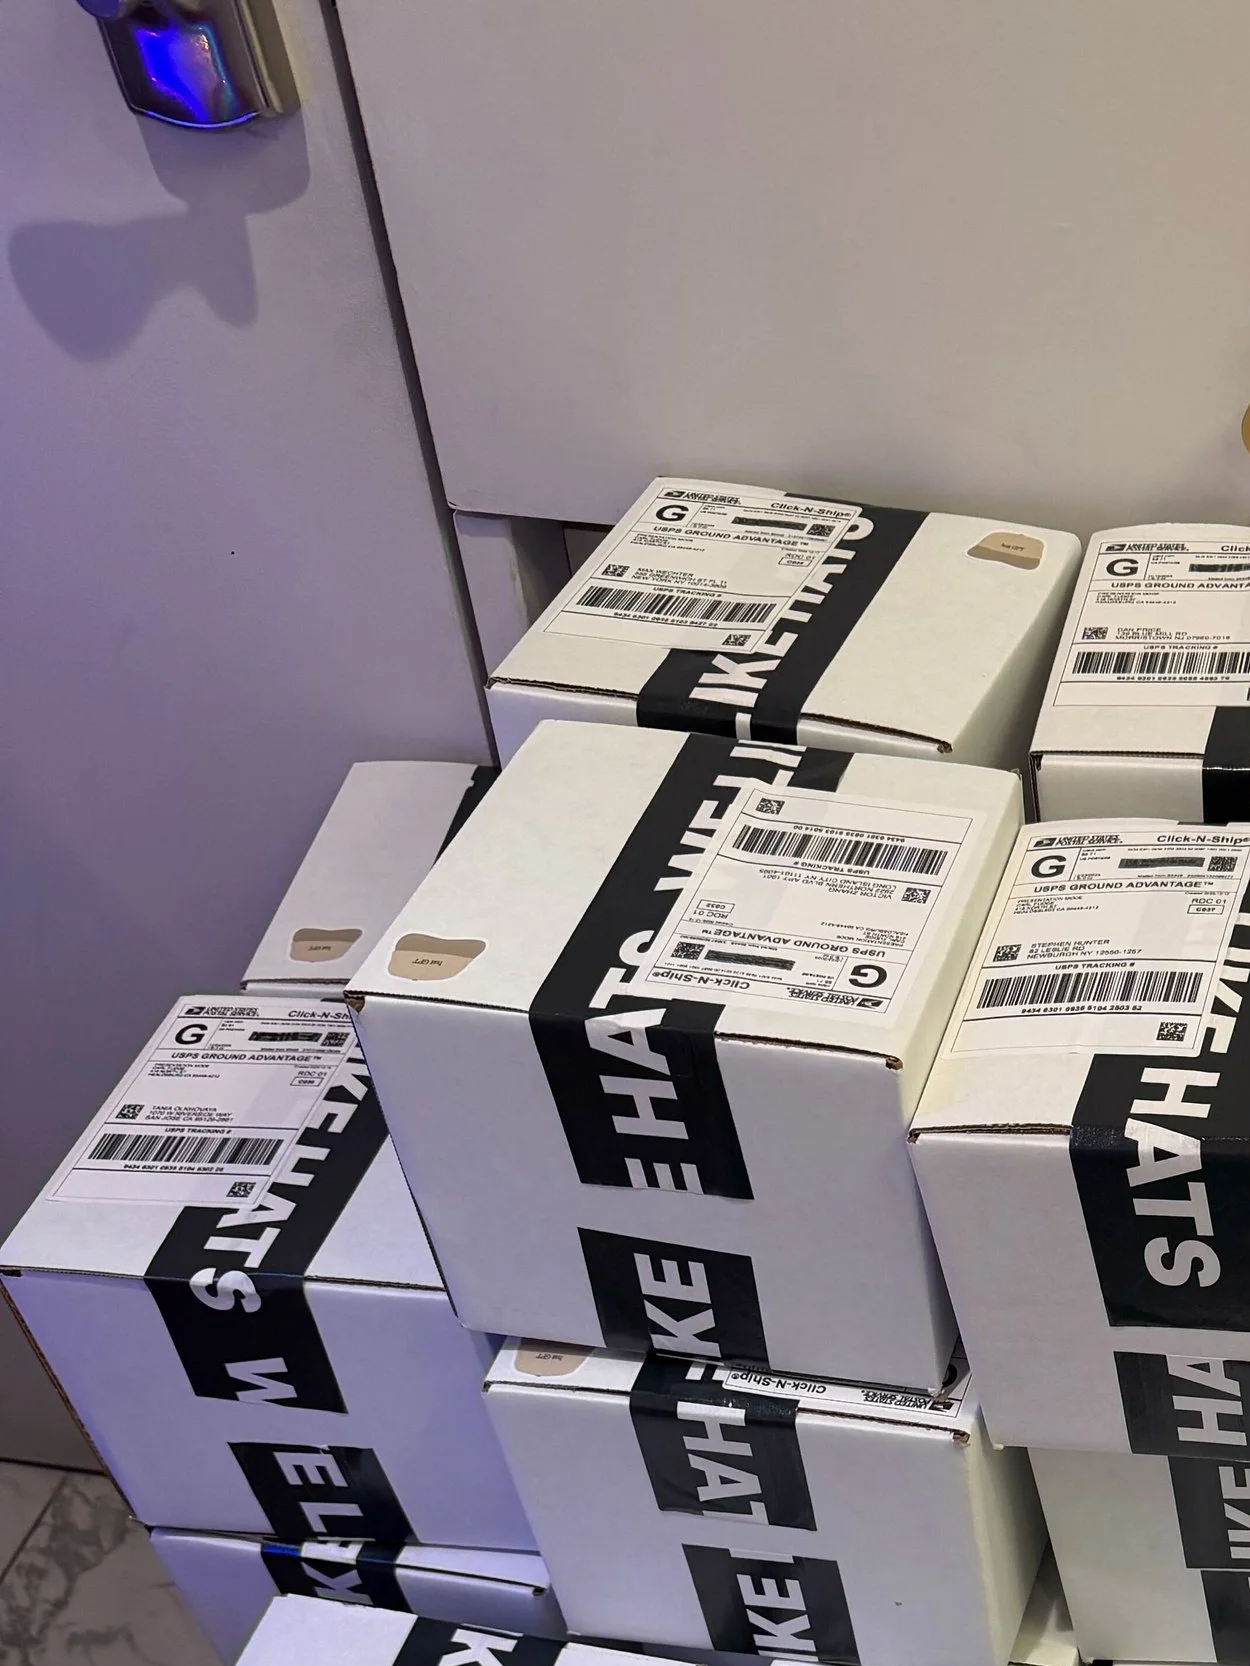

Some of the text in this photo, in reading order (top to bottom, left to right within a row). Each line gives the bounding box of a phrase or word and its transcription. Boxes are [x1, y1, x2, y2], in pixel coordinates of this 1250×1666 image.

[654, 503, 690, 522] G
[652, 525, 683, 534] USPS
[683, 528, 732, 539] GROUND
[1105, 557, 1139, 577] G
[1110, 581, 1142, 589] USPS
[1143, 581, 1195, 589] GROUND
[800, 861, 844, 873] TRACKING
[1030, 854, 1067, 879] G
[1033, 883, 1067, 893] USPS
[1068, 881, 1123, 891] GROUND
[792, 939, 849, 953] GROUND
[851, 946, 886, 958] USPS
[1081, 961, 1128, 969] TRACKING
[847, 963, 888, 989] G
[174, 1022, 208, 1046] G
[170, 1051, 200, 1060] USPS
[200, 1052, 247, 1061] GROUND
[1123, 1065, 1221, 1287] HATS
